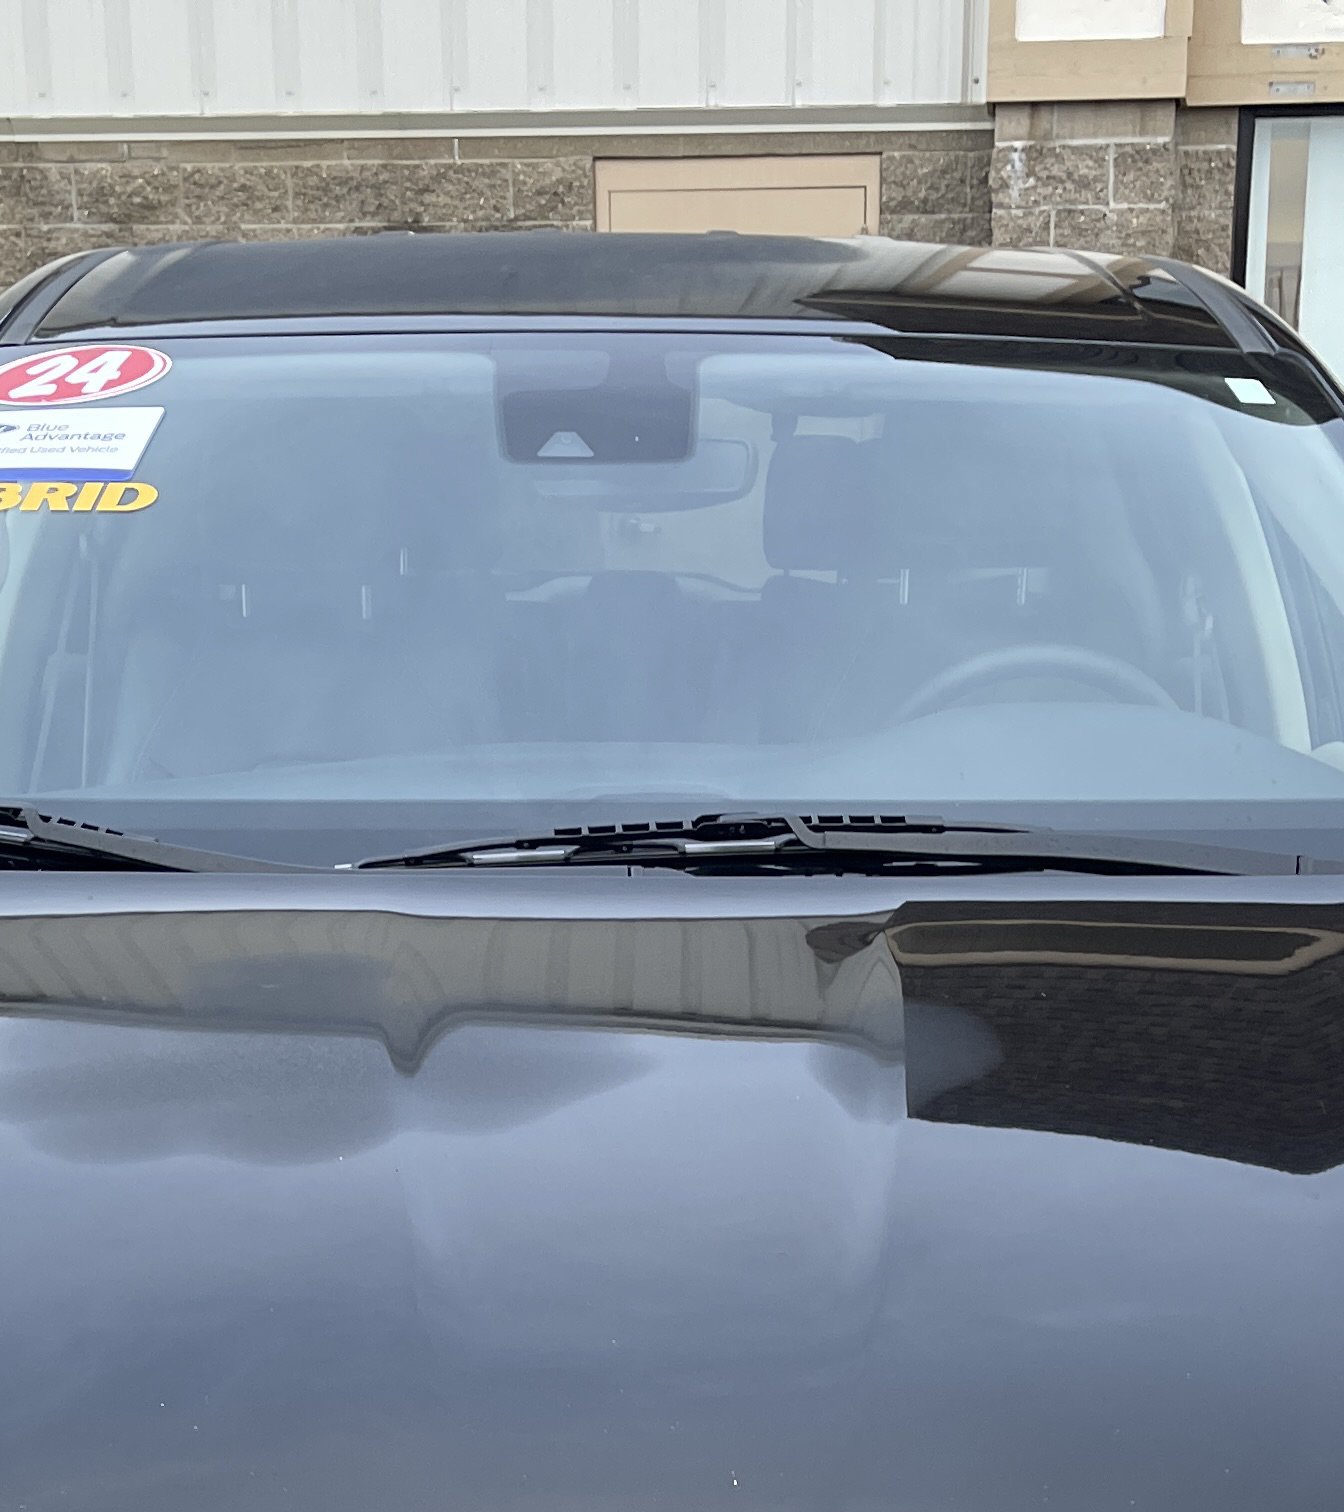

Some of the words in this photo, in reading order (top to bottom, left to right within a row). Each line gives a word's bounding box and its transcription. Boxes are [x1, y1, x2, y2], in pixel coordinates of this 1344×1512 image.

[8, 351, 133, 399] 24
[27, 423, 69, 432] Blue
[19, 431, 126, 442] Advantage
[70, 445, 118, 454] Vehicle
